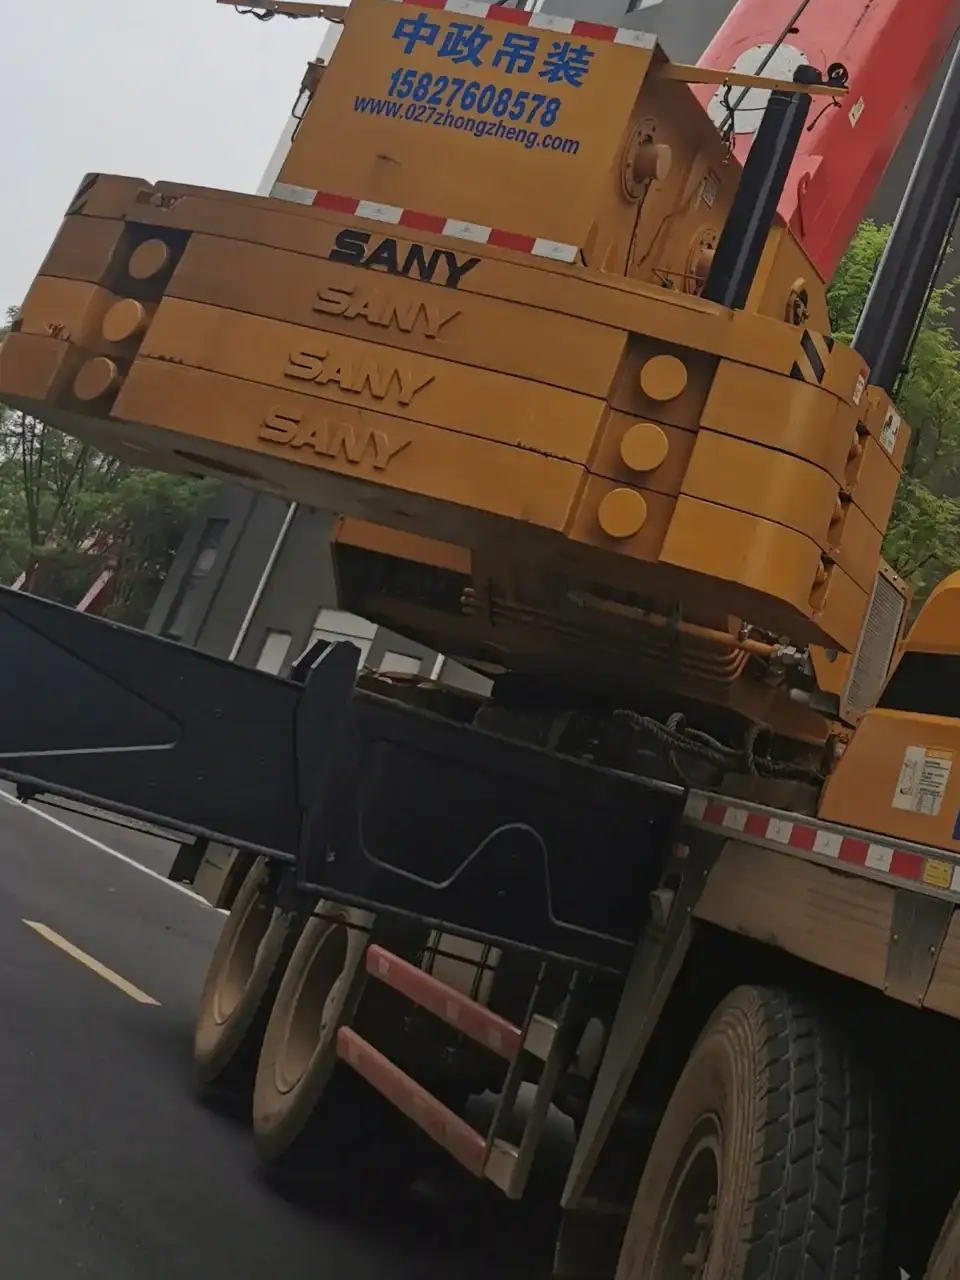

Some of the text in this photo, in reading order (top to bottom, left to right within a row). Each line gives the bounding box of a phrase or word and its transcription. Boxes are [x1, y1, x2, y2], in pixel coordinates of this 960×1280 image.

[392, 12, 596, 88] 中政吊装
[353, 95, 581, 155] www.027zhongzheng.com
[388, 67, 561, 128] 15827608578
[328, 228, 482, 289] SANY
[312, 284, 463, 340] SANY
[284, 346, 436, 407] SANY
[257, 405, 412, 471] SANY
